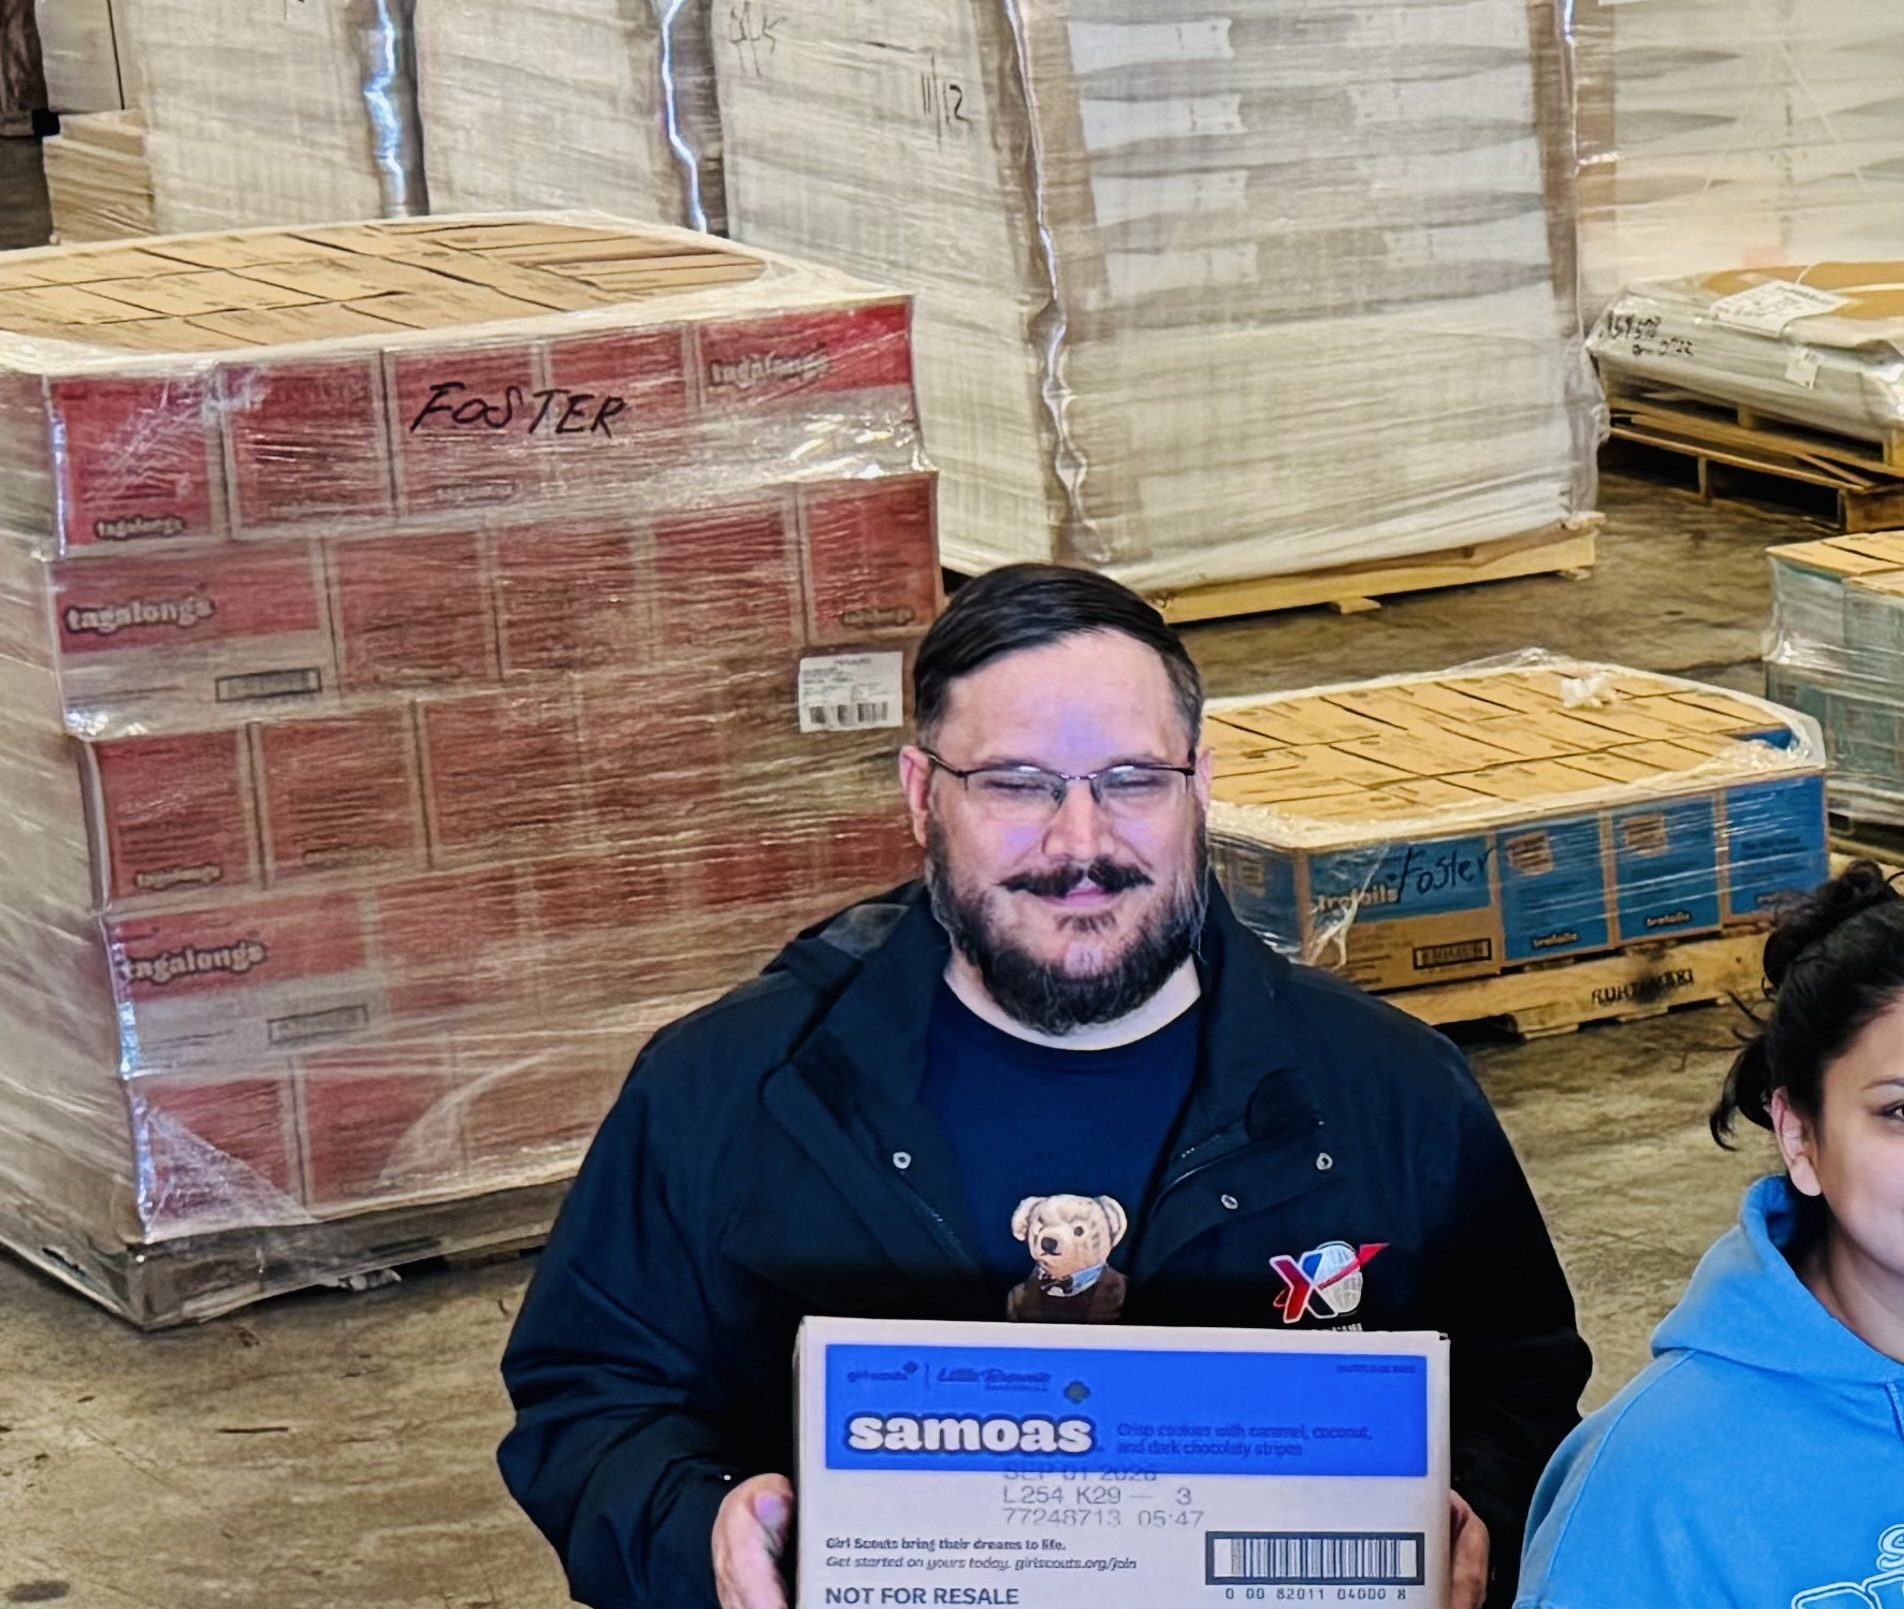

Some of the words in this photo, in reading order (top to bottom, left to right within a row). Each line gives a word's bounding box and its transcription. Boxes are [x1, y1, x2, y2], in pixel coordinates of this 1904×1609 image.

[409, 381, 630, 439] FOSTER
[65, 596, 215, 635] tagalongs
[1399, 845, 1496, 895] Foster
[118, 940, 268, 986] tagalongs
[846, 1413, 1094, 1454] samoas
[1002, 1464, 1046, 1480] SEP
[1062, 1464, 1088, 1480] 01
[1101, 1465, 1158, 1480] 2026
[1076, 1486, 1121, 1504] K29
[1176, 1487, 1192, 1505] 3
[1003, 1508, 1121, 1527] 77248713
[826, 1537, 850, 1550] Girl
[854, 1538, 898, 1550] Scouts
[902, 1538, 935, 1552] bring
[939, 1538, 970, 1550] their
[973, 1538, 1022, 1550] dreams
[1025, 1539, 1038, 1550] to
[1042, 1538, 1066, 1550] life.
[826, 1587, 874, 1604] NOT
[881, 1587, 927, 1604] FOR
[933, 1587, 1019, 1605] RESALE
[1225, 1588, 1235, 1600] 0
[1246, 1588, 1265, 1600] 00
[1276, 1588, 1325, 1600] 82011
[1337, 1588, 1386, 1600] 04000
